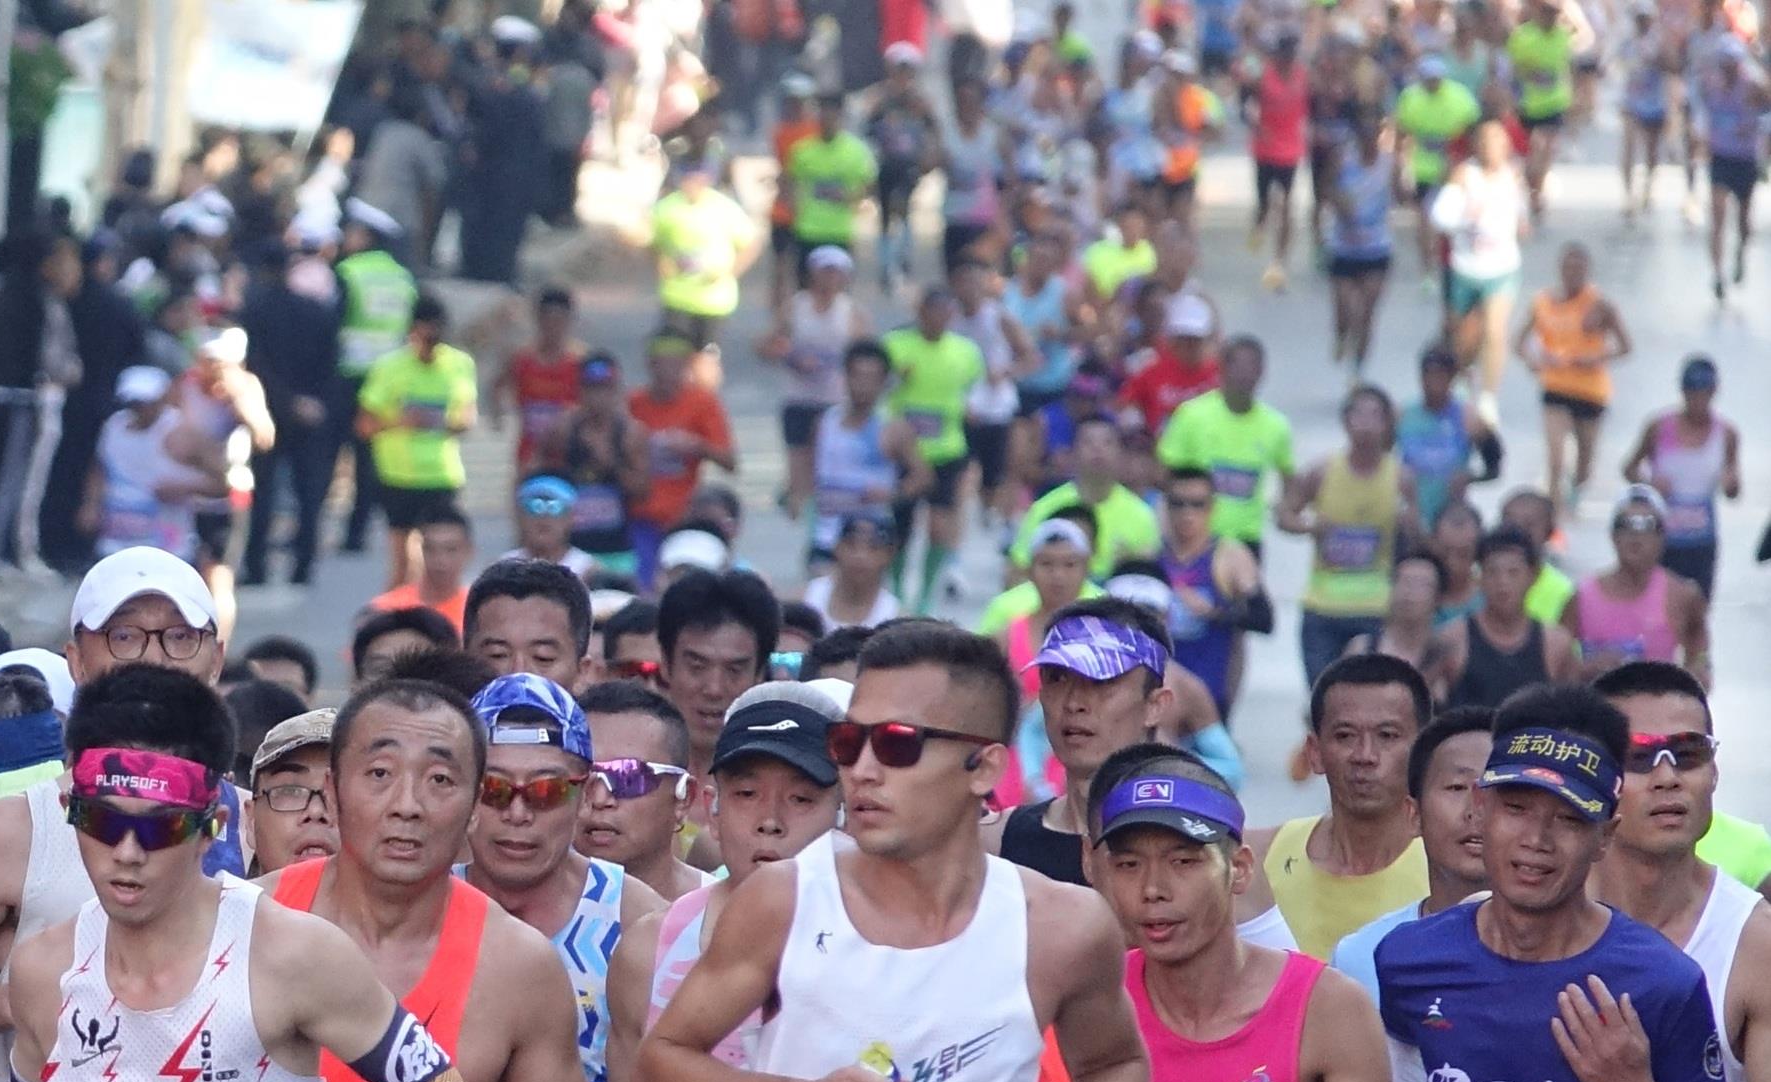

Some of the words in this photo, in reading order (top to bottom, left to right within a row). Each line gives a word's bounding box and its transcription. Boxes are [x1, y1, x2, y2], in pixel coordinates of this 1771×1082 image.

[1506, 732, 1602, 777] 流动护卫
[95, 774, 169, 793] PLAYSOFT
